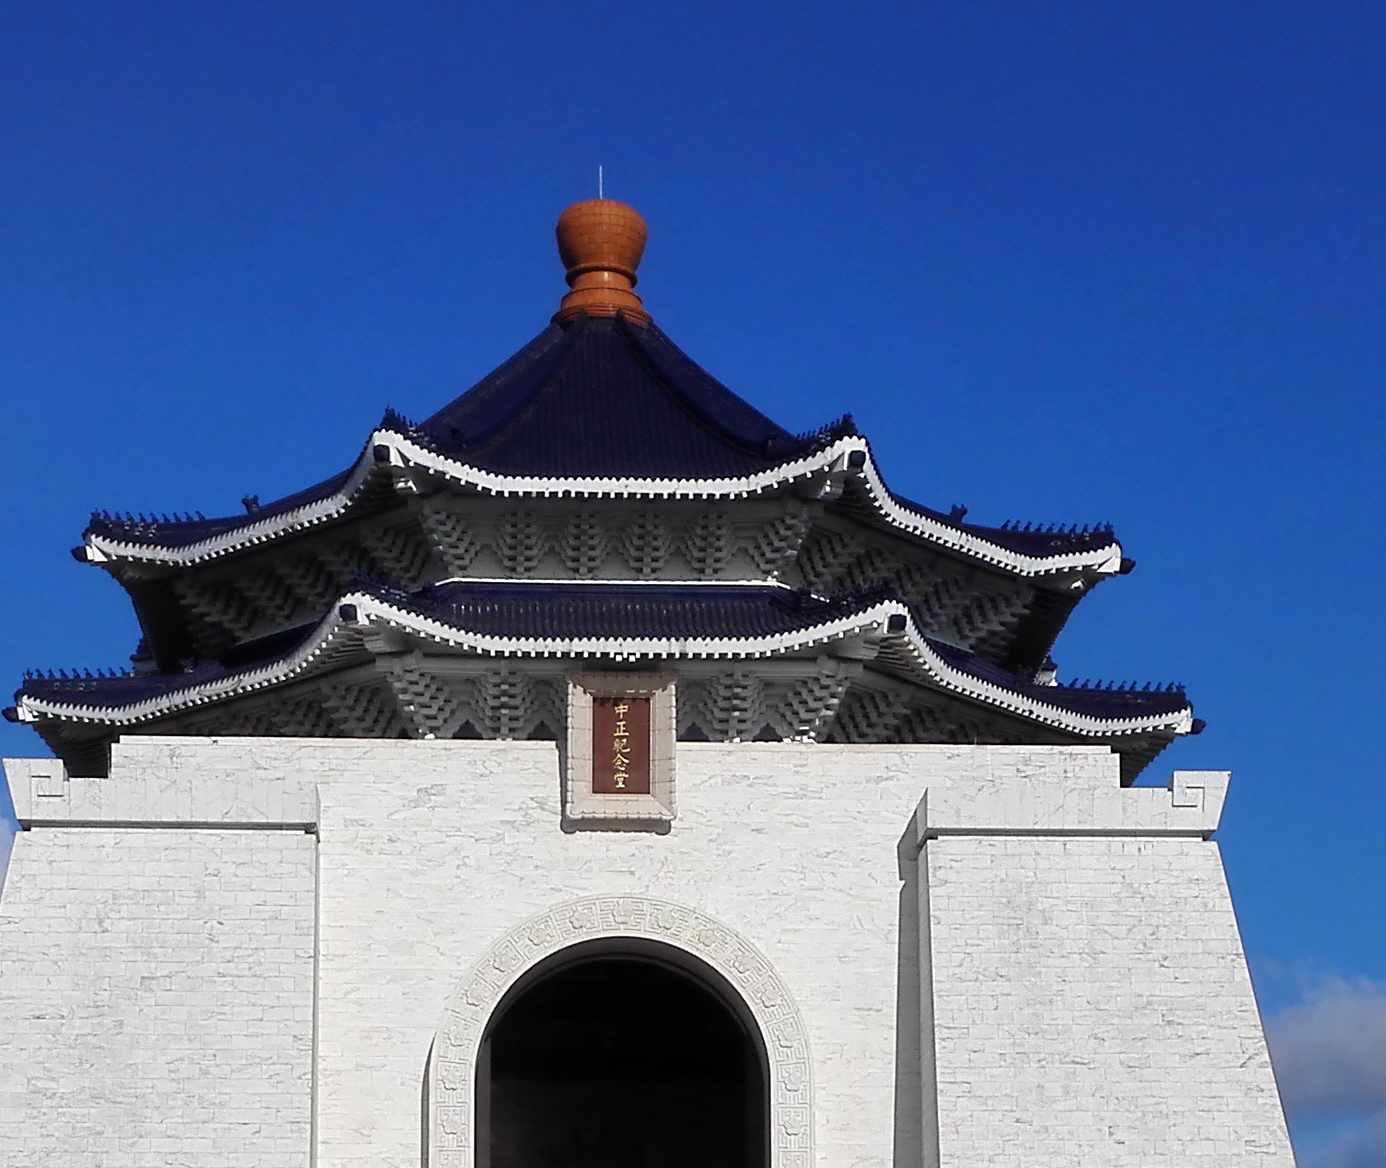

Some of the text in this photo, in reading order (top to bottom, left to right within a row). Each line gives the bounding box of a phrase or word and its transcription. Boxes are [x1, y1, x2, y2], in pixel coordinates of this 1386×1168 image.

[613, 703, 631, 788] 中正紀念堂
